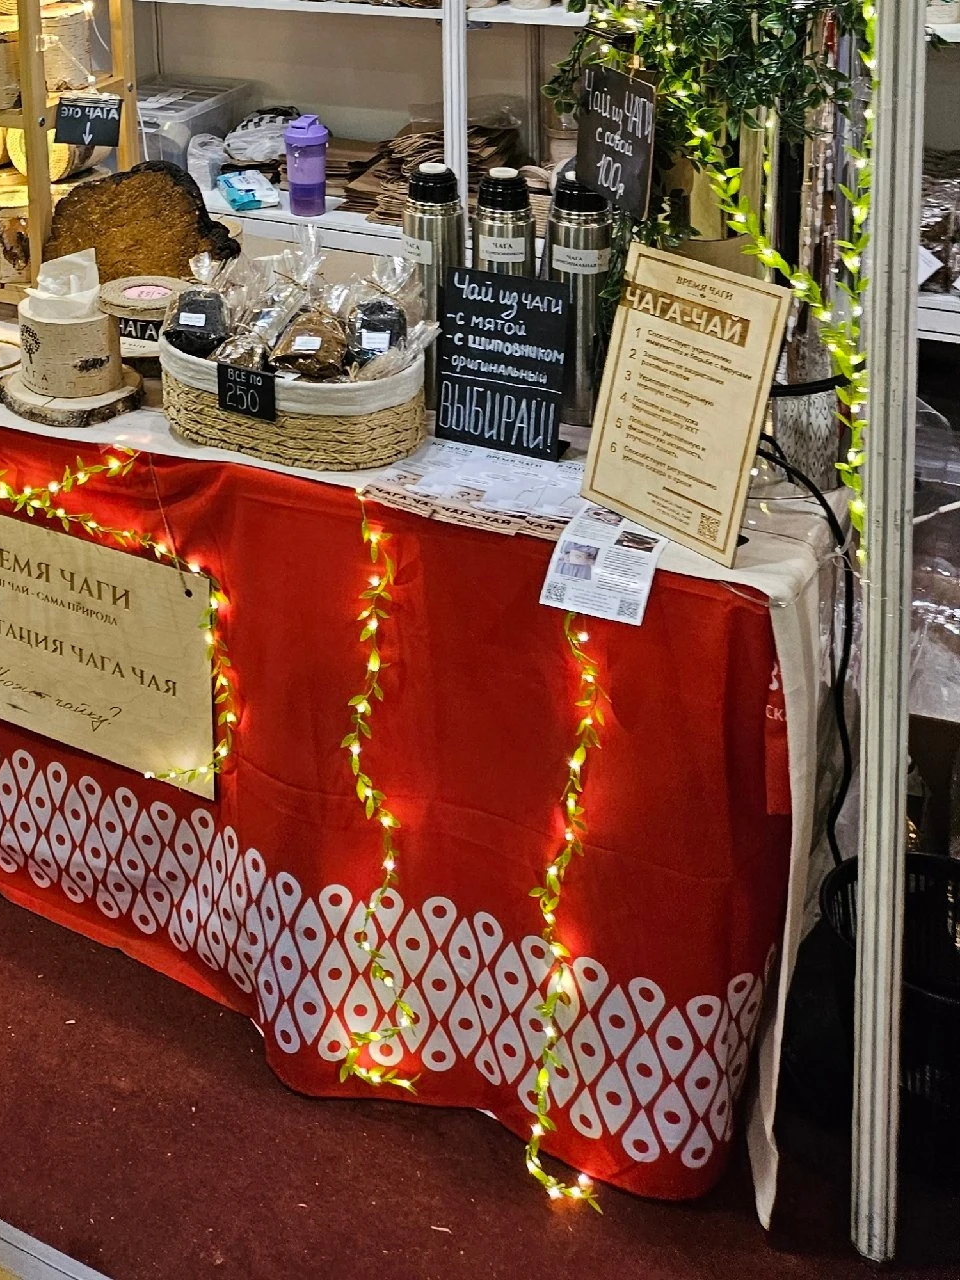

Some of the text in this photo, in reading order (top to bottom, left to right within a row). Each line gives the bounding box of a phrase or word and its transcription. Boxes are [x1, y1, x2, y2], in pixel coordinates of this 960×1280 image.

[585, 69, 611, 118] Чай
[85, 107, 119, 120] ЧАГА
[604, 131, 633, 157] собой
[492, 242, 513, 250] ЧАГА
[454, 272, 495, 303] Чай
[499, 289, 519, 319] из
[676, 276, 734, 301] ВРЕМЯ ЧАГИ
[626, 286, 743, 345] ЧАГА-ЧАЙ
[635, 327, 641, 338] 1
[629, 348, 637, 360] 2
[227, 368, 247, 382] ВСЕ
[624, 370, 632, 381] 3
[226, 382, 260, 413] 250
[620, 391, 628, 403] 4
[439, 380, 555, 453] ВЫБИРАЙ!
[615, 417, 623, 428] 5
[610, 441, 617, 453] 6
[375, 487, 434, 508] ЧАГА ЧА
[442, 506, 512, 526] ЧАГА ЧАЯ
[526, 520, 556, 531] ЧАЯ
[60, 568, 131, 612] ЧАГИ
[7, 580, 29, 595] ЧАЙ
[37, 592, 65, 608] САМА
[68, 602, 118, 626] ПРИРОДА
[71, 644, 125, 679] ЧАГА
[132, 667, 177, 697] ЧАЯ
[56, 699, 122, 731] чайку?
